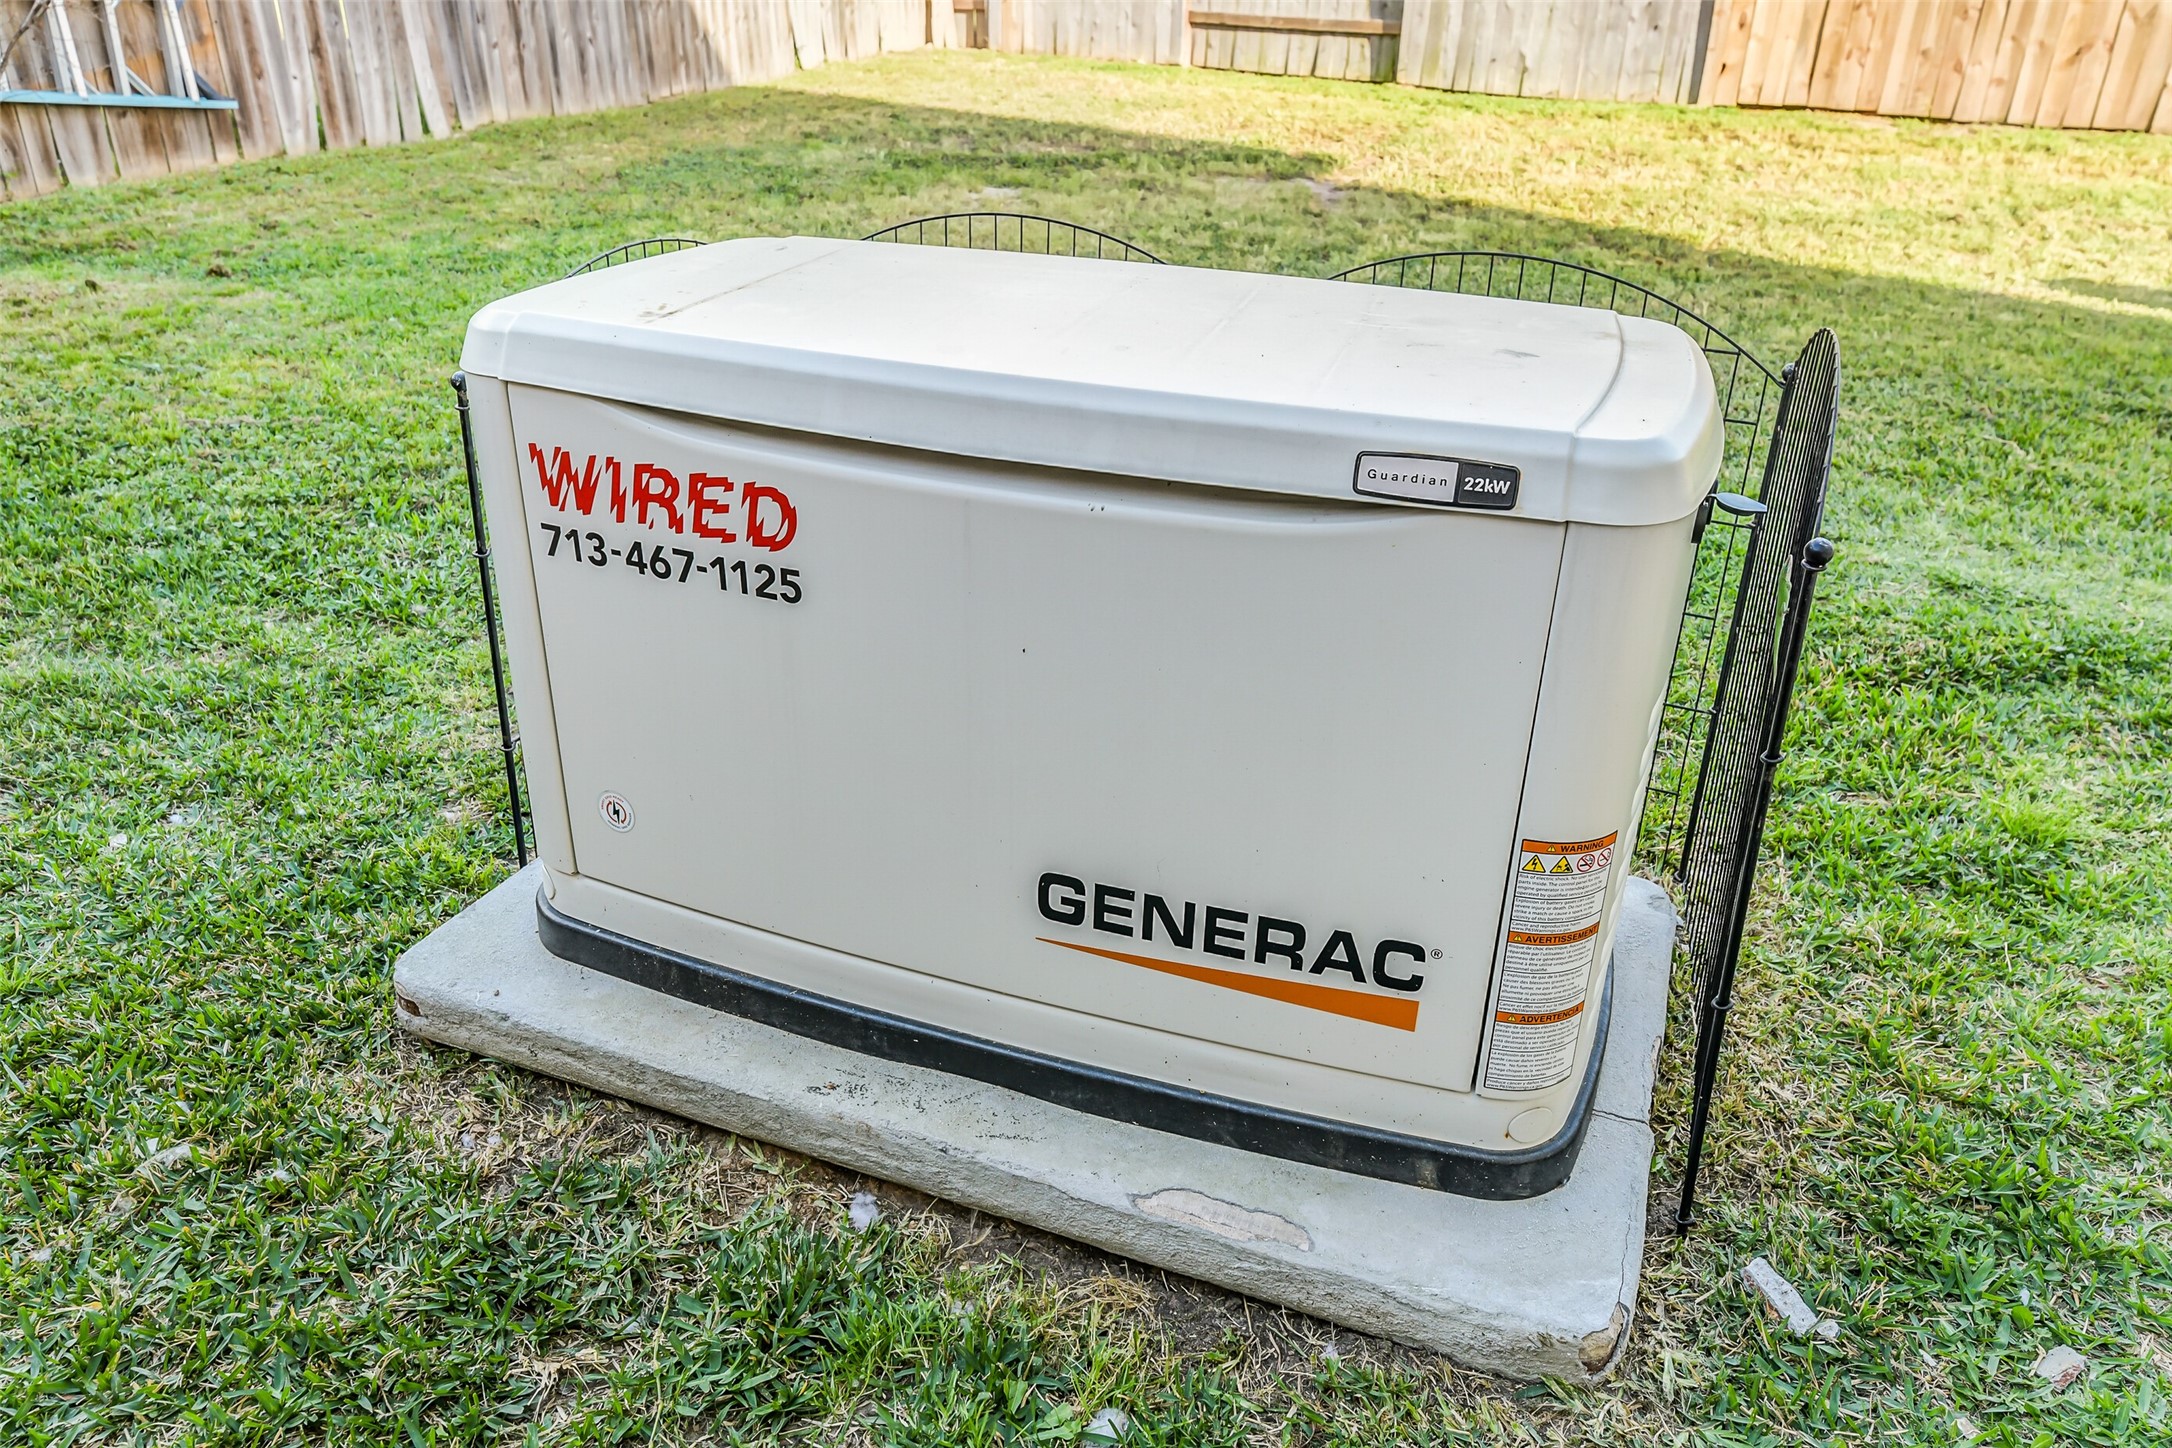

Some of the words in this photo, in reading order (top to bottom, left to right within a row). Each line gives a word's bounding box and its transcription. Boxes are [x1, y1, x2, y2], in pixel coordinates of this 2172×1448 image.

[1367, 468, 1448, 486] Guardian
[1464, 477, 1510, 495] 22kW
[528, 442, 798, 552] WIRED
[540, 522, 803, 604] 713-467-1125
[1560, 840, 1604, 852] WARNING
[1036, 871, 1427, 993] GENERAC
[1525, 925, 1597, 944] AVERTISSEMENT
[1520, 1006, 1579, 1023] ADVERTENCIA
